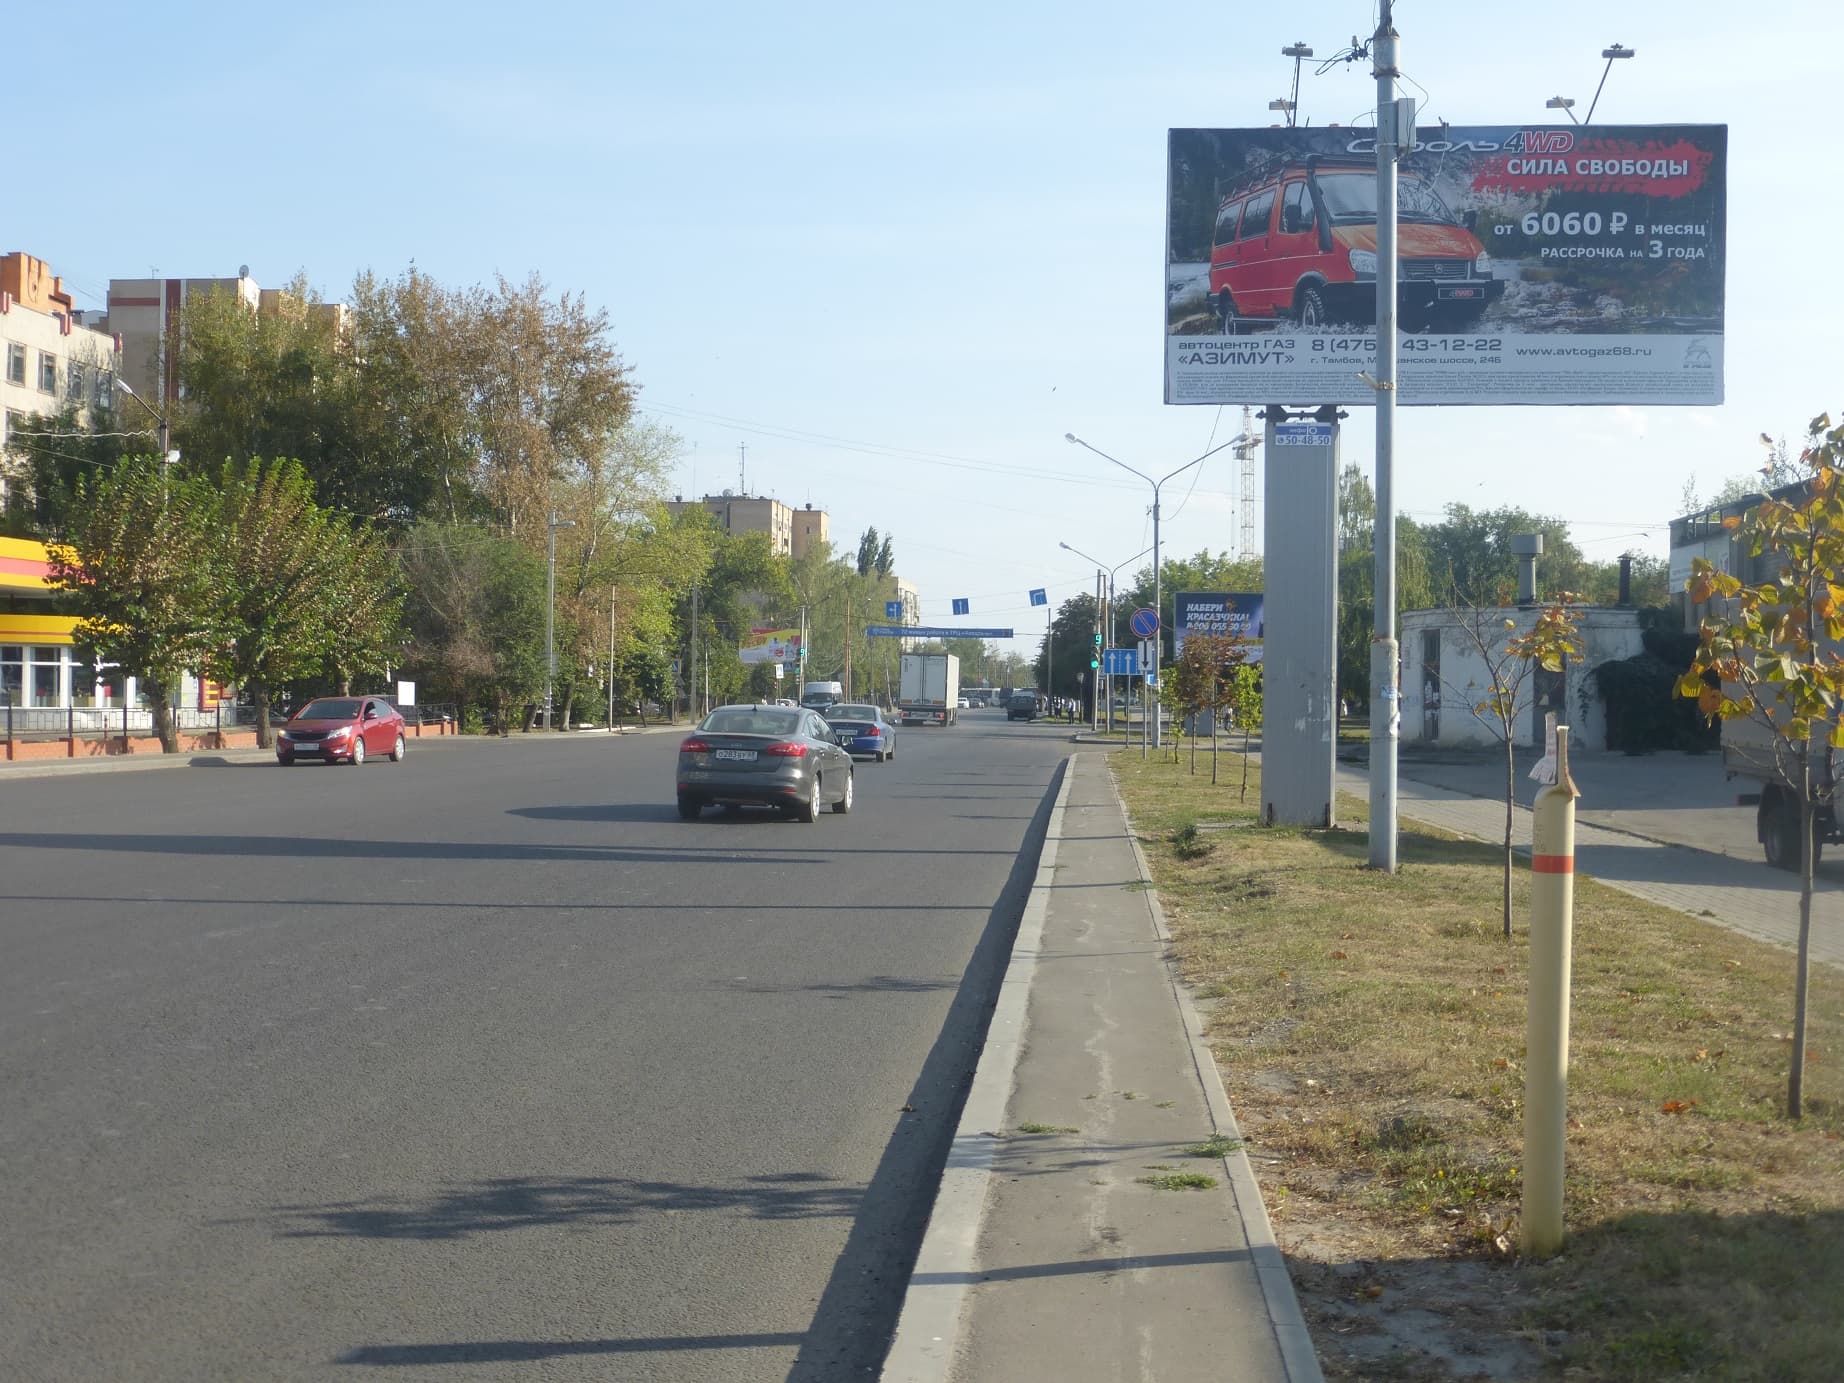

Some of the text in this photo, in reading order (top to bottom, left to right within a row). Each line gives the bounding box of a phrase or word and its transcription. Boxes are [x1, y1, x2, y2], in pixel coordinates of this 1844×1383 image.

[1346, 131, 1574, 153] Соль 4WD
[1507, 159, 1688, 178] СИЛА СВОБОДЫ
[1494, 224, 1514, 235] от
[1521, 211, 1602, 236] 6060
[1635, 224, 1645, 235] в
[1541, 247, 1625, 258] РАССРОЧКА
[1648, 240, 1663, 258] 3
[1667, 247, 1705, 259] ГОДА
[1178, 339, 1295, 351] автоцентр ГАЗ
[1311, 339, 1324, 351] 8
[1402, 339, 1502, 351] 43-12-22
[1516, 346, 1652, 357] www.avtogaz68.ru
[1178, 352, 1295, 365] «АЗИМУТ»
[1322, 356, 1365, 364] Тамбов,
[1286, 435, 1330, 445] 50-48-50
[1186, 603, 1224, 612] НАБЕРИ
[1095, 634, 1102, 644] 9
